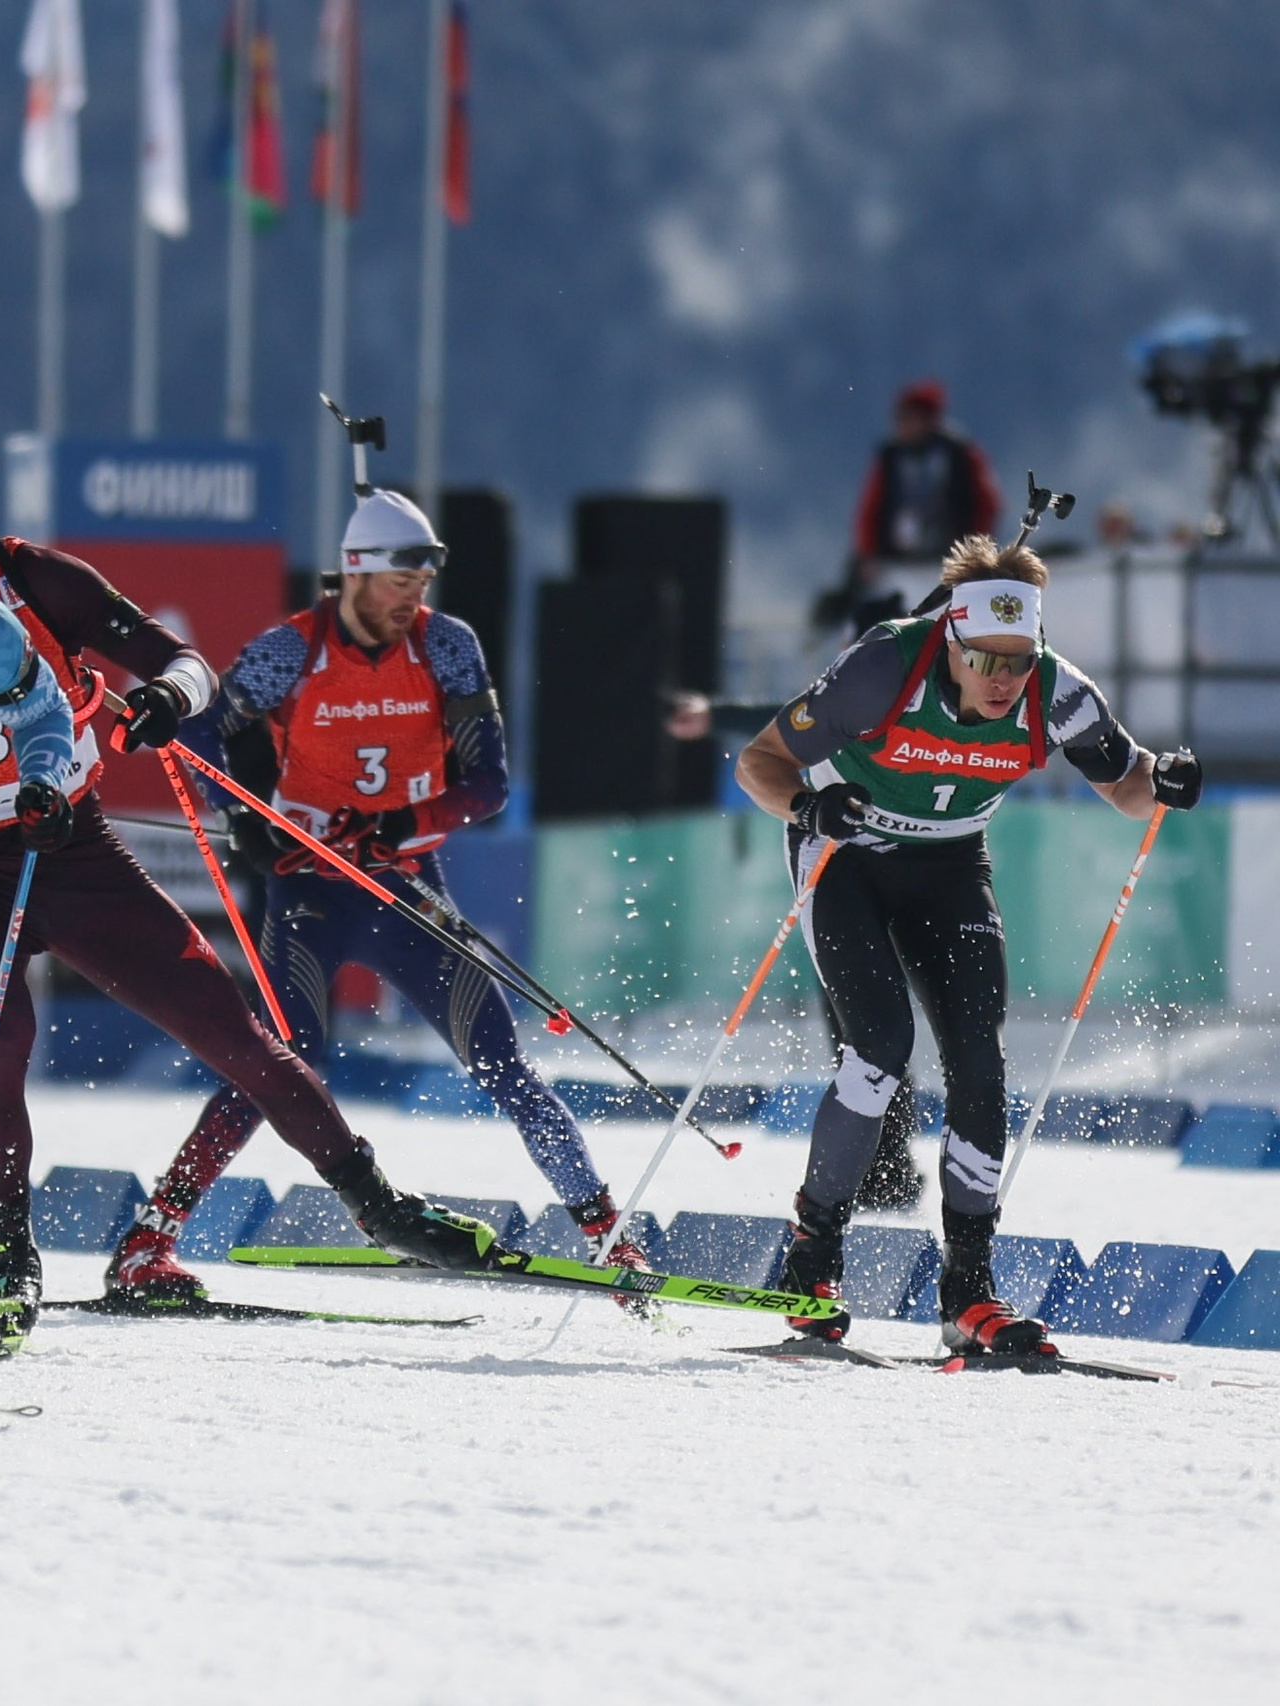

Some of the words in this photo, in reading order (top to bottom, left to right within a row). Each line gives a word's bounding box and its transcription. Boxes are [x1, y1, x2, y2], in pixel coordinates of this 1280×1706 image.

[83, 459, 256, 518] ФИНИШ
[314, 701, 379, 726] Альфа
[382, 698, 431, 716] Банк
[890, 742, 965, 766] Альфа
[968, 752, 1021, 770] Банк
[353, 746, 389, 797] 3
[932, 784, 957, 812] 1
[686, 1284, 801, 1312] FISCHER
